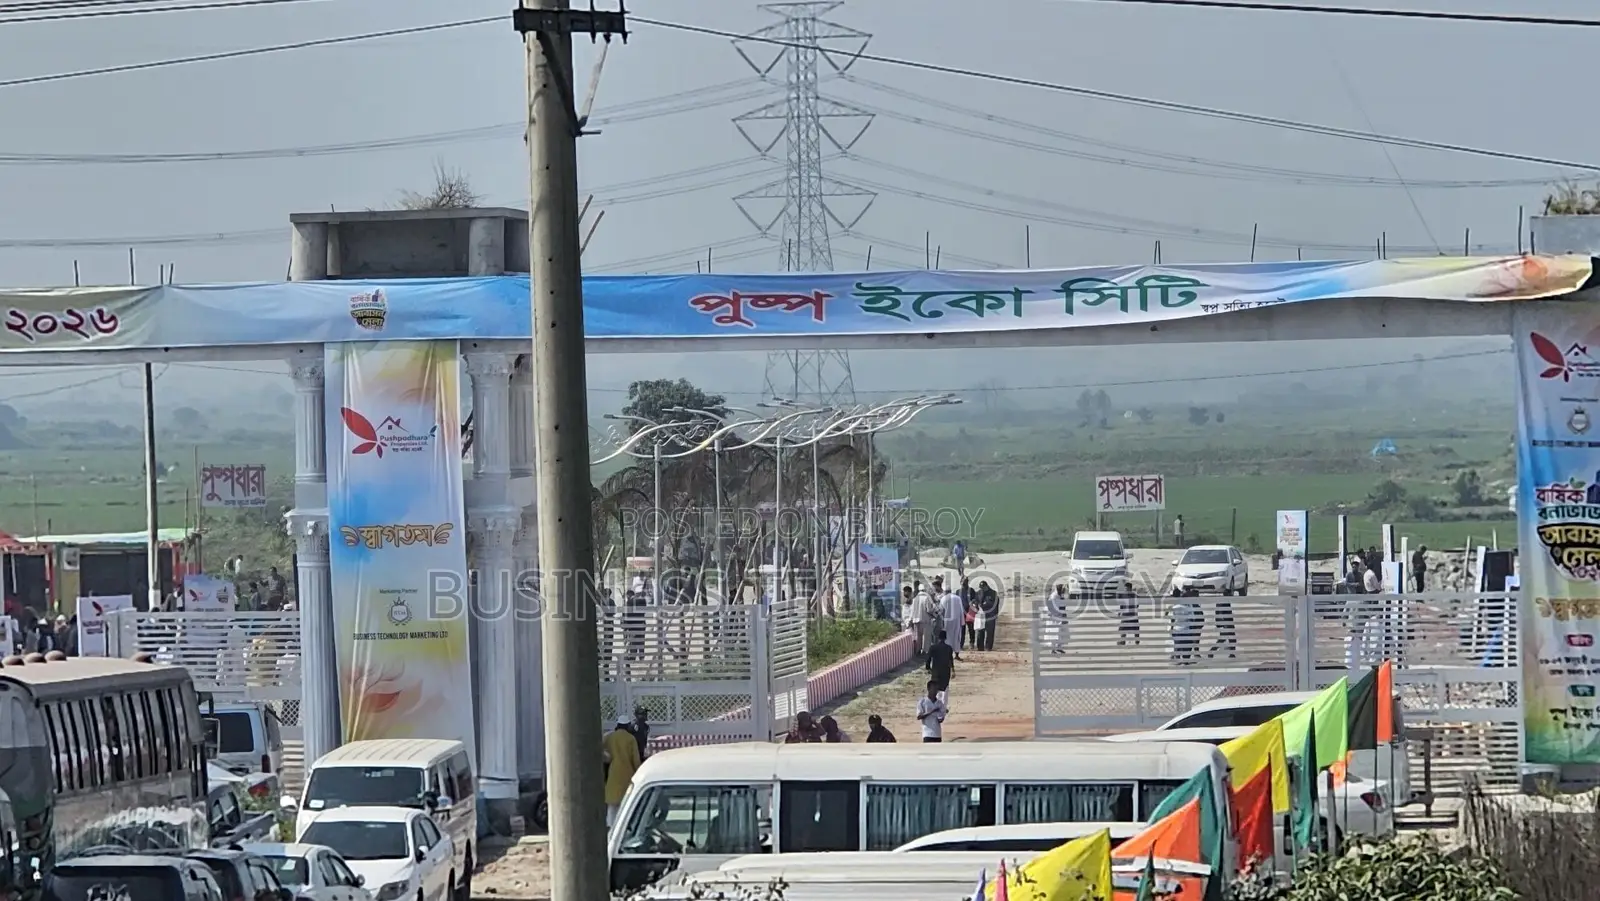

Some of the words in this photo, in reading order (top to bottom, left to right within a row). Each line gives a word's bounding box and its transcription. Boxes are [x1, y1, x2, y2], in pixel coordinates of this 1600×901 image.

[688, 289, 835, 328] পুষ্প
[851, 281, 1035, 322] ইকো
[1052, 274, 1211, 315] সিটি
[4, 307, 120, 341] ২০২৬
[380, 434, 428, 442] Pushpodhara
[202, 464, 266, 501] পুষ্পধারা
[1097, 475, 1163, 509] পুষ্পধারা
[1536, 483, 1585, 503] বার্ষিক
[353, 632, 376, 640] BUSINESS
[377, 632, 408, 640] TECHNOLOGY
[409, 631, 438, 639] MARKETING
